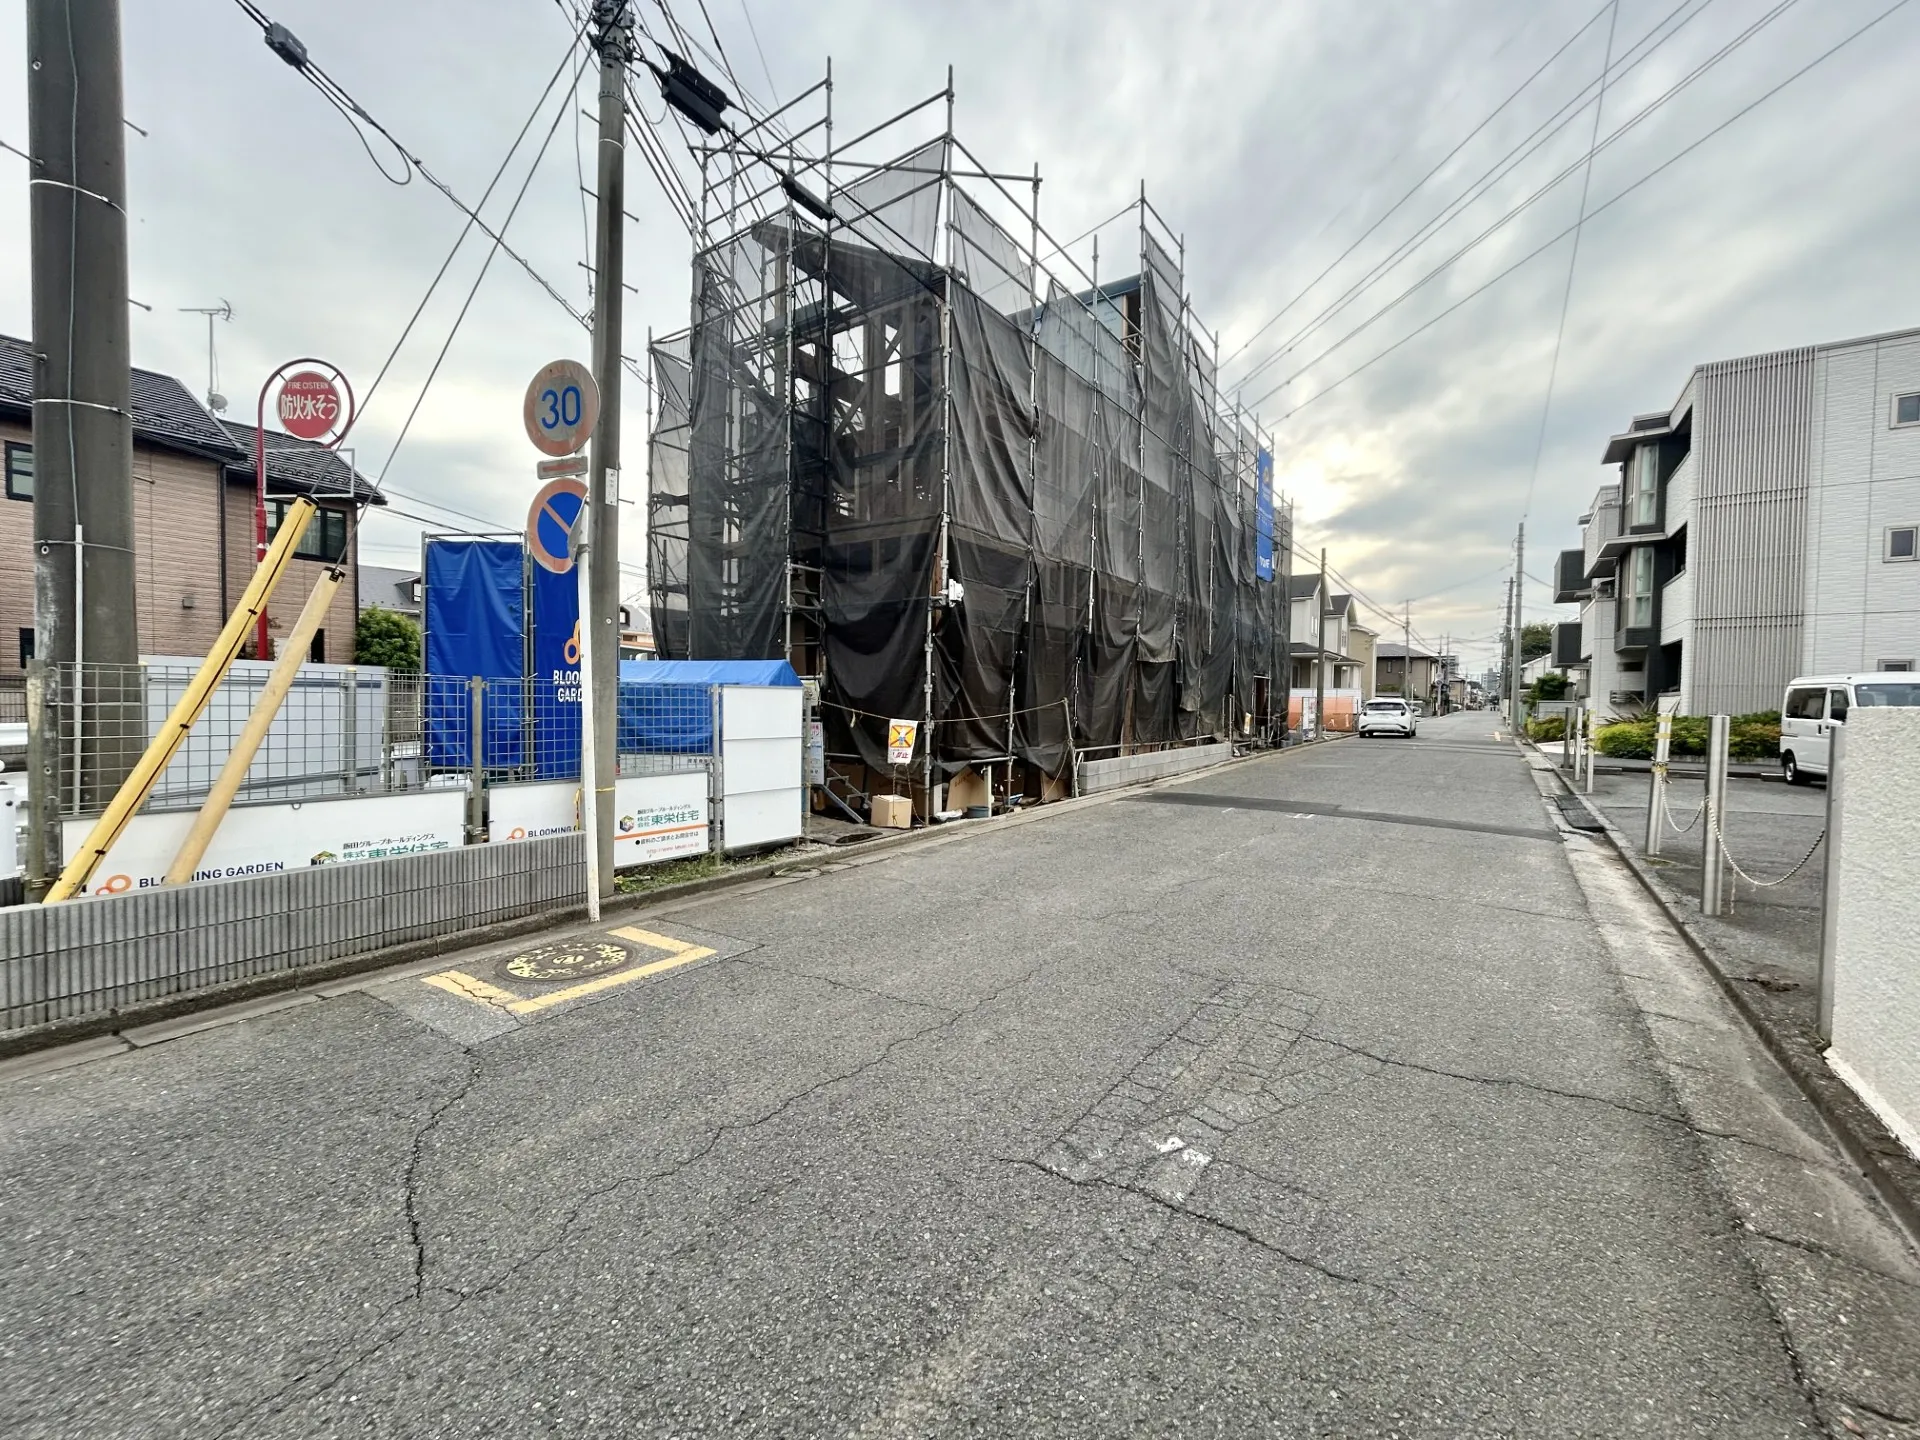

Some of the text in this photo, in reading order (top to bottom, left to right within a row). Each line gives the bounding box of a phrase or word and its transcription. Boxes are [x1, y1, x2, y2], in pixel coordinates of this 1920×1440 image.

[287, 381, 329, 390] FIRE CISTERN
[281, 393, 338, 420] 防火水そう
[541, 385, 581, 430] 30
[553, 669, 582, 685] BLOO
[651, 809, 699, 826] 東栄住宅
[528, 825, 572, 838] BLOOMING
[139, 861, 284, 888] BLING GARDEN
